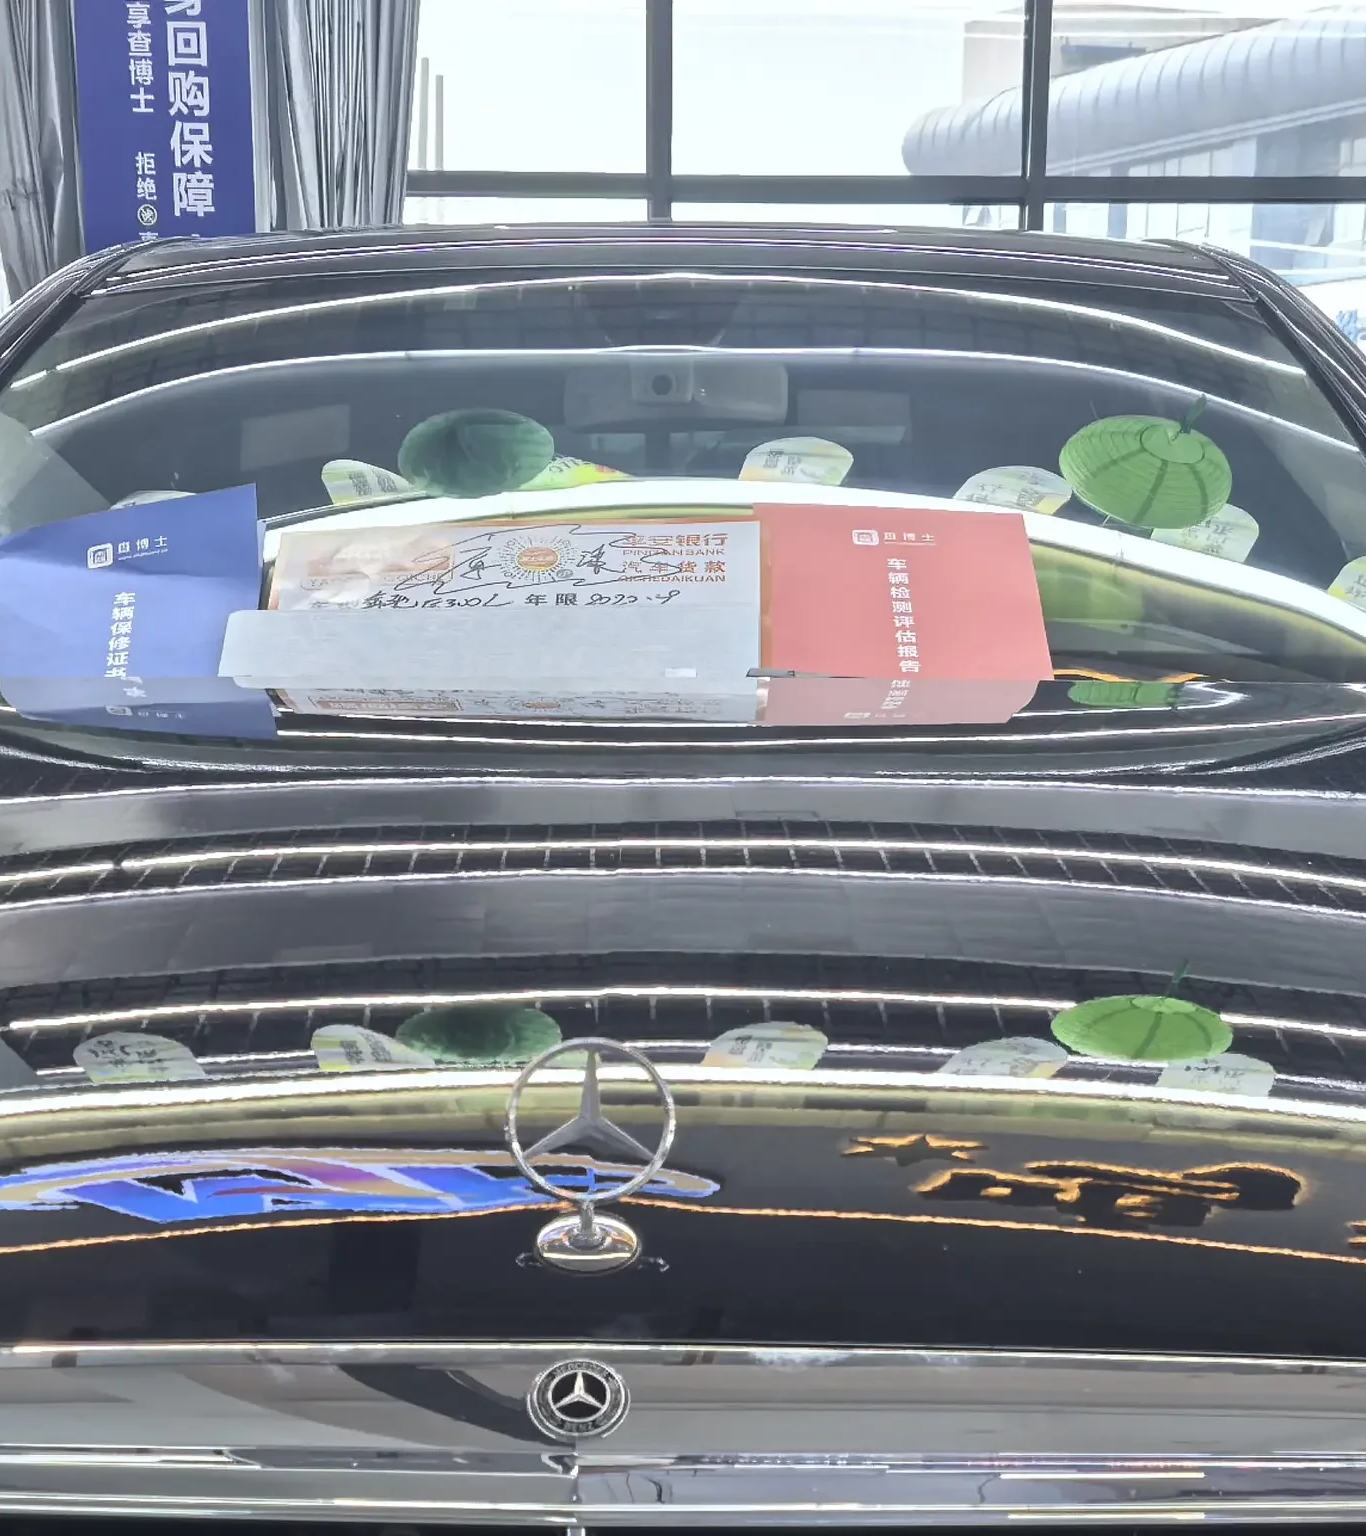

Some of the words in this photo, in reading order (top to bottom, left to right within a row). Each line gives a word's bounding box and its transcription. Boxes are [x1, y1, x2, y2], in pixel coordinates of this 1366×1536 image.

[126, 1, 155, 113] 享查博士
[135, 151, 158, 201] 拒绝
[524, 592, 579, 606] 年限
[622, 560, 726, 574] 汽车贷款
[104, 592, 136, 678] 车辆保修证书
[887, 557, 922, 673] 车辆检测评估报告
